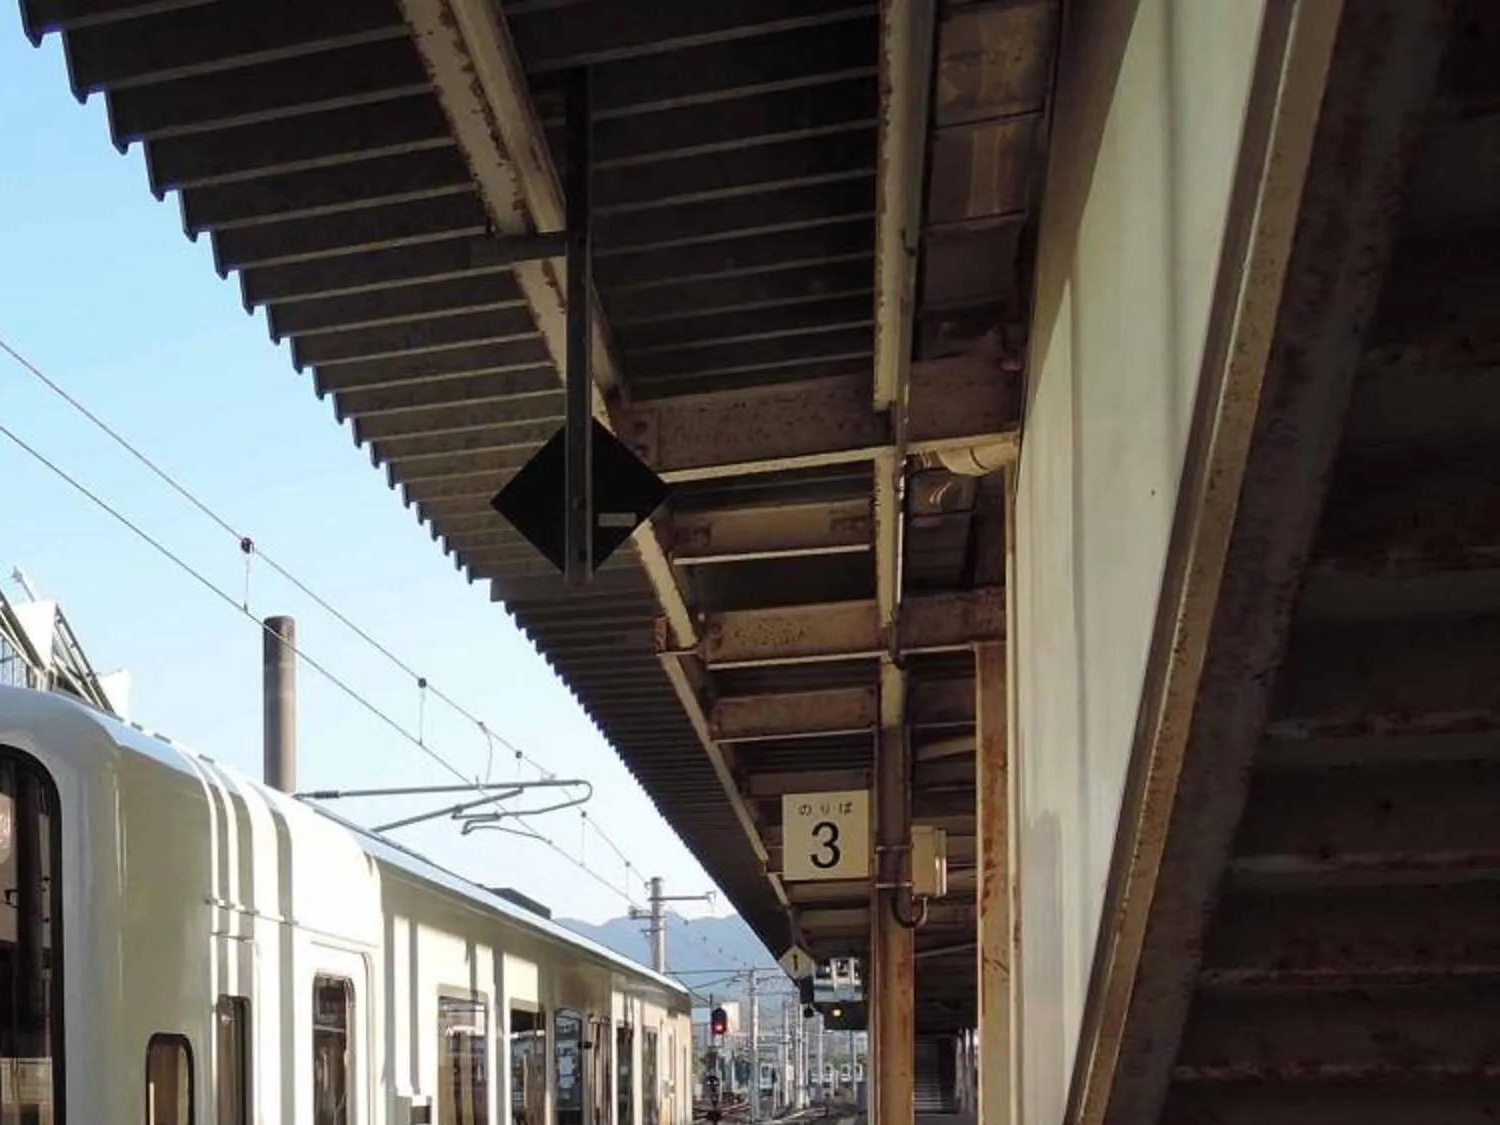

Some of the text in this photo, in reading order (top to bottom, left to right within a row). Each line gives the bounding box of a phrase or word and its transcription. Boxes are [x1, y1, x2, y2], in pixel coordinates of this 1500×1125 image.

[798, 801, 853, 817] のりば
[810, 821, 841, 869] 3
